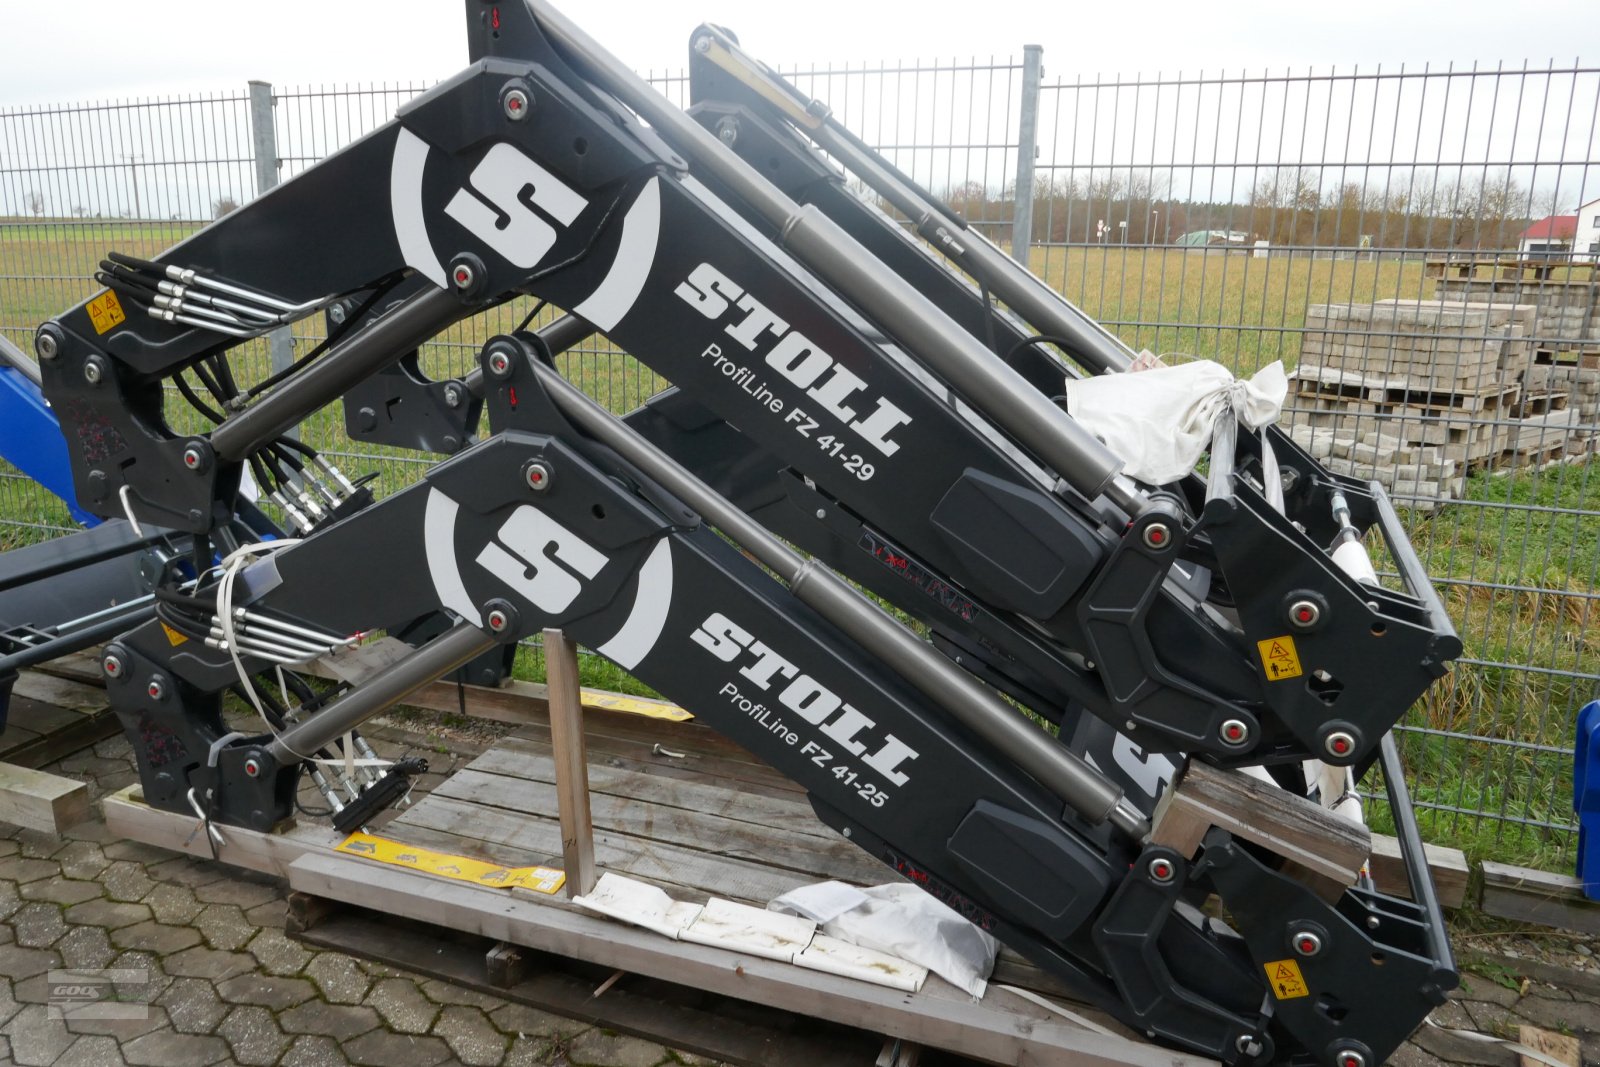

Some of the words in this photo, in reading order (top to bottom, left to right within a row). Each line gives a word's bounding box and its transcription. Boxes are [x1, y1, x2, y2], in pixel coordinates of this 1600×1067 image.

[444, 142, 589, 269] S
[673, 262, 913, 458] STOLL
[701, 342, 784, 414] ProfiLine
[784, 407, 820, 438] FZ
[816, 434, 875, 482] 41-29
[475, 504, 610, 615] S
[689, 612, 920, 788] STOLL
[718, 682, 799, 746] ProfiLine
[800, 740, 834, 768] FZ
[831, 765, 890, 808] 41-25
